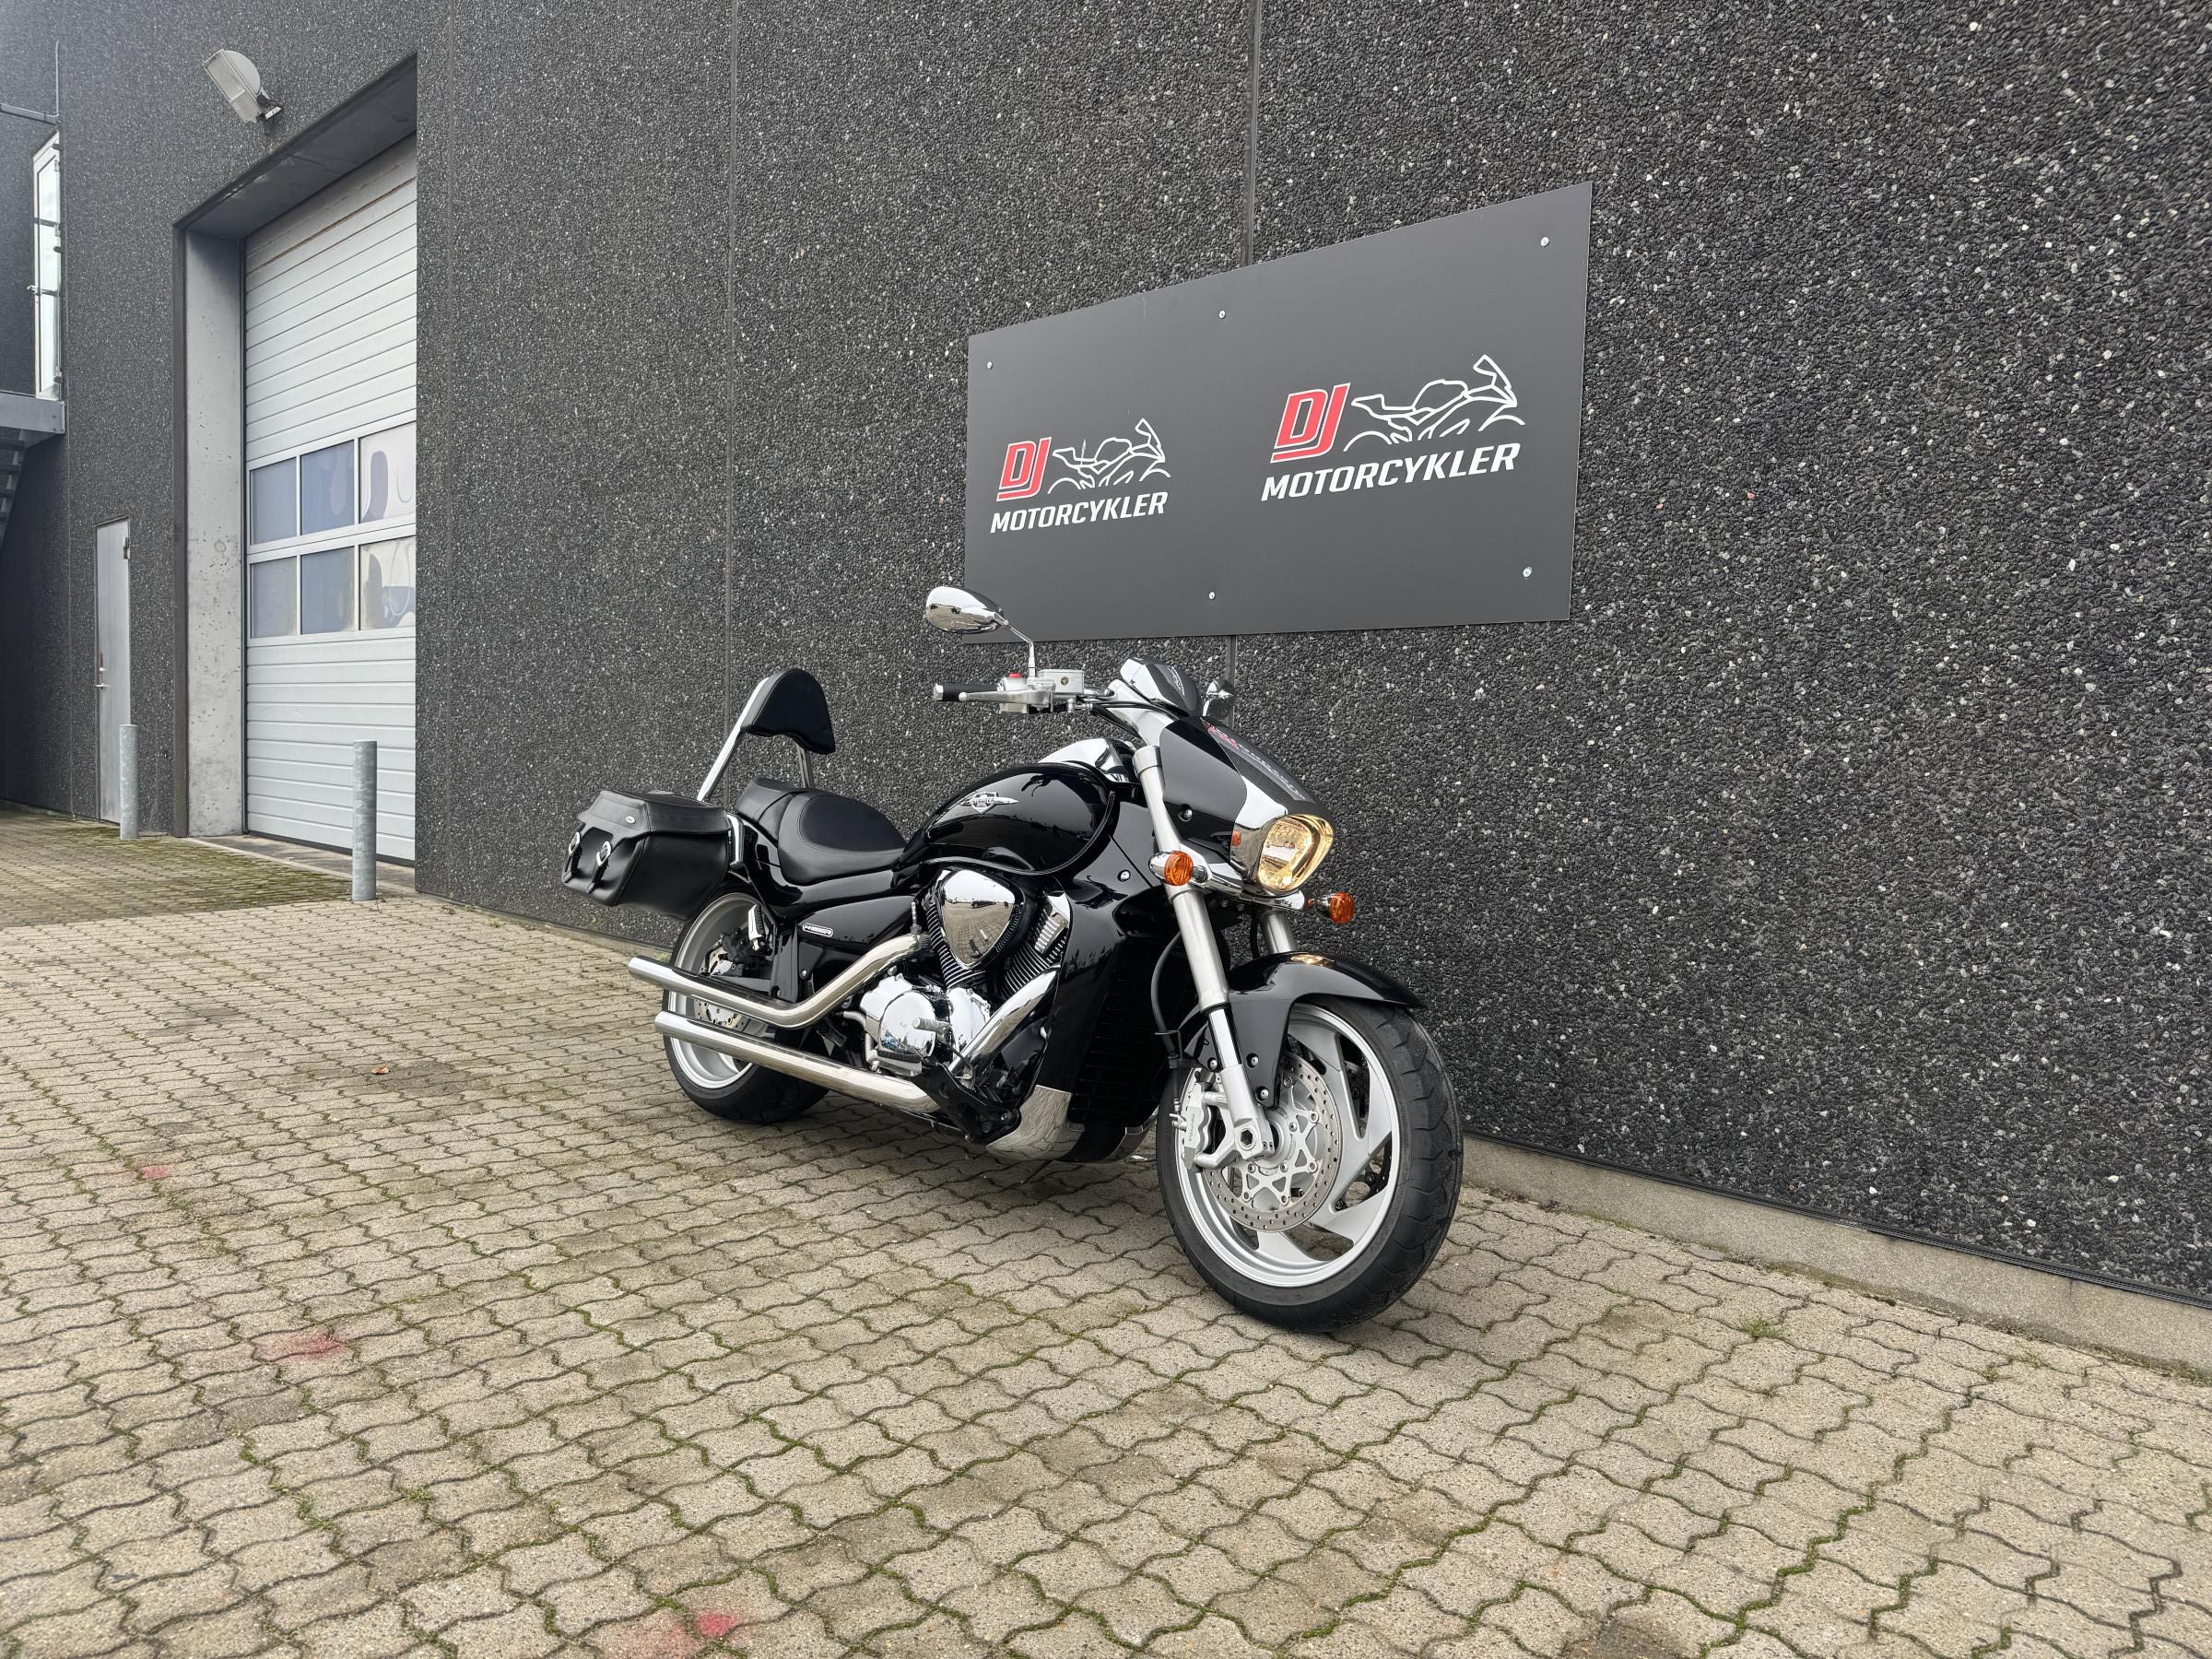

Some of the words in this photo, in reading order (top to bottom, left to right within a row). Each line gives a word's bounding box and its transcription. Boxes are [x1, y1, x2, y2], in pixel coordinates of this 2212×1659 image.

[1270, 382, 1351, 463] DJ
[996, 436, 1052, 501] DJ
[1261, 442, 1521, 501] MOTORCYKLER
[990, 491, 1168, 533] MOTORCYKLER
